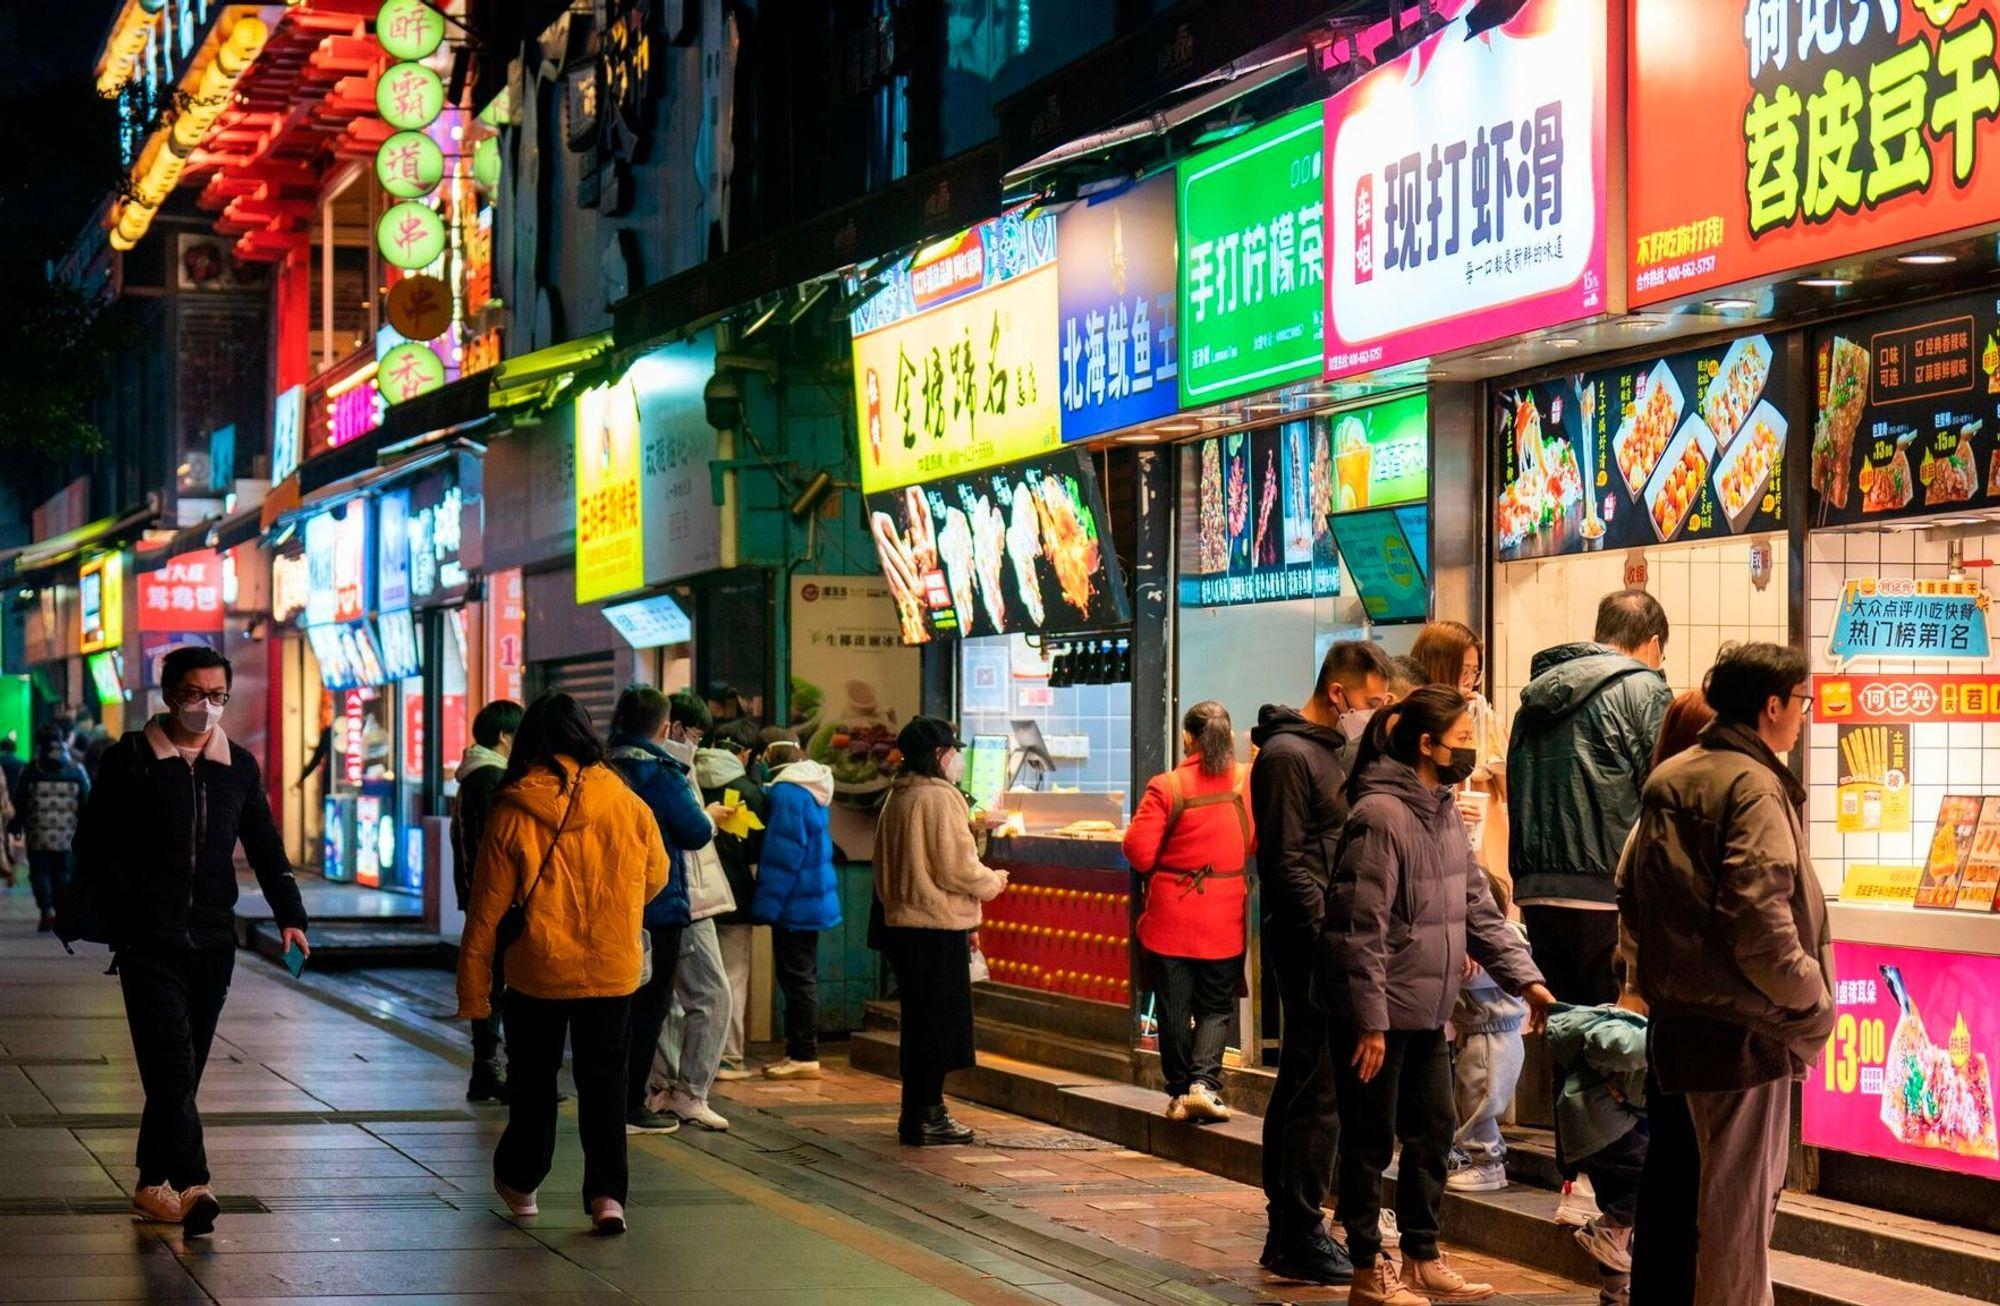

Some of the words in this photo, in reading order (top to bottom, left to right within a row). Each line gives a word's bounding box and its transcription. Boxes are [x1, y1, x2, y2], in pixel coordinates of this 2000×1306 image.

[1744, 18, 2000, 234] 苕皮豆干
[1384, 100, 1564, 271] 现打虾滑
[1465, 234, 1564, 285] 每一口都是新鲜的味道
[1880, 345, 1899, 366] 口味
[1879, 367, 1899, 387] 可选
[1853, 599, 1975, 621] 大众点评小吃快餐
[1848, 620, 1970, 650] 热门榜第1名
[1865, 688, 1934, 710] 何记兴
